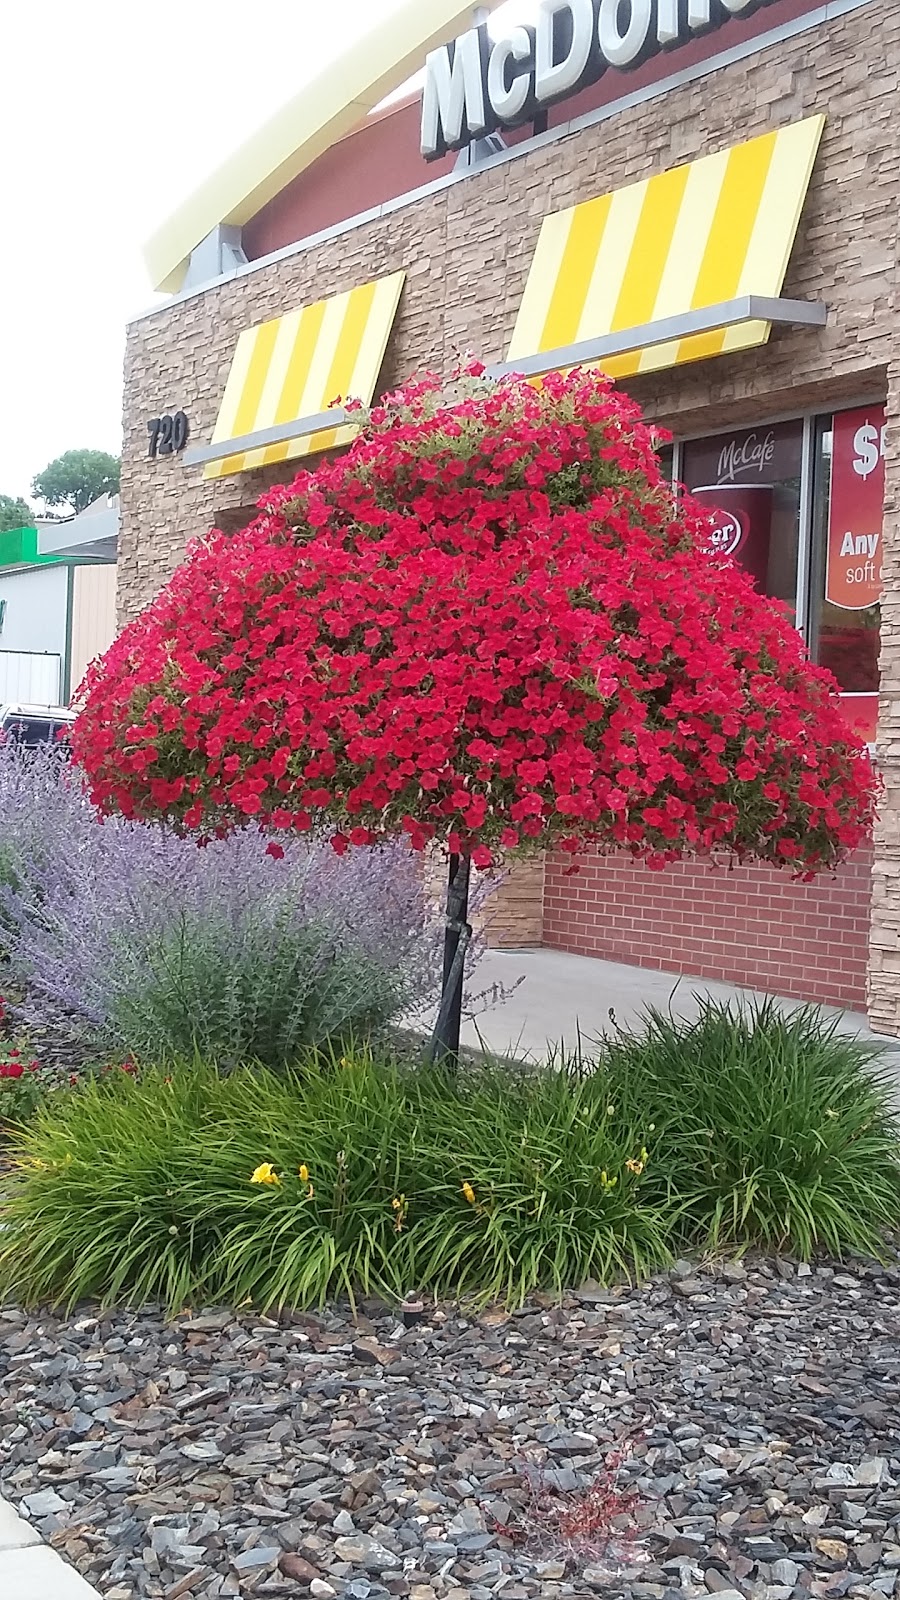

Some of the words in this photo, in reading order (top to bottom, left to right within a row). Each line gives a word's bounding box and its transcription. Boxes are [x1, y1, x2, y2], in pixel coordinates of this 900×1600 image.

[147, 411, 188, 457] 720
[717, 430, 775, 481] McCafé
[840, 531, 879, 558] Any
[846, 560, 876, 583] soft
